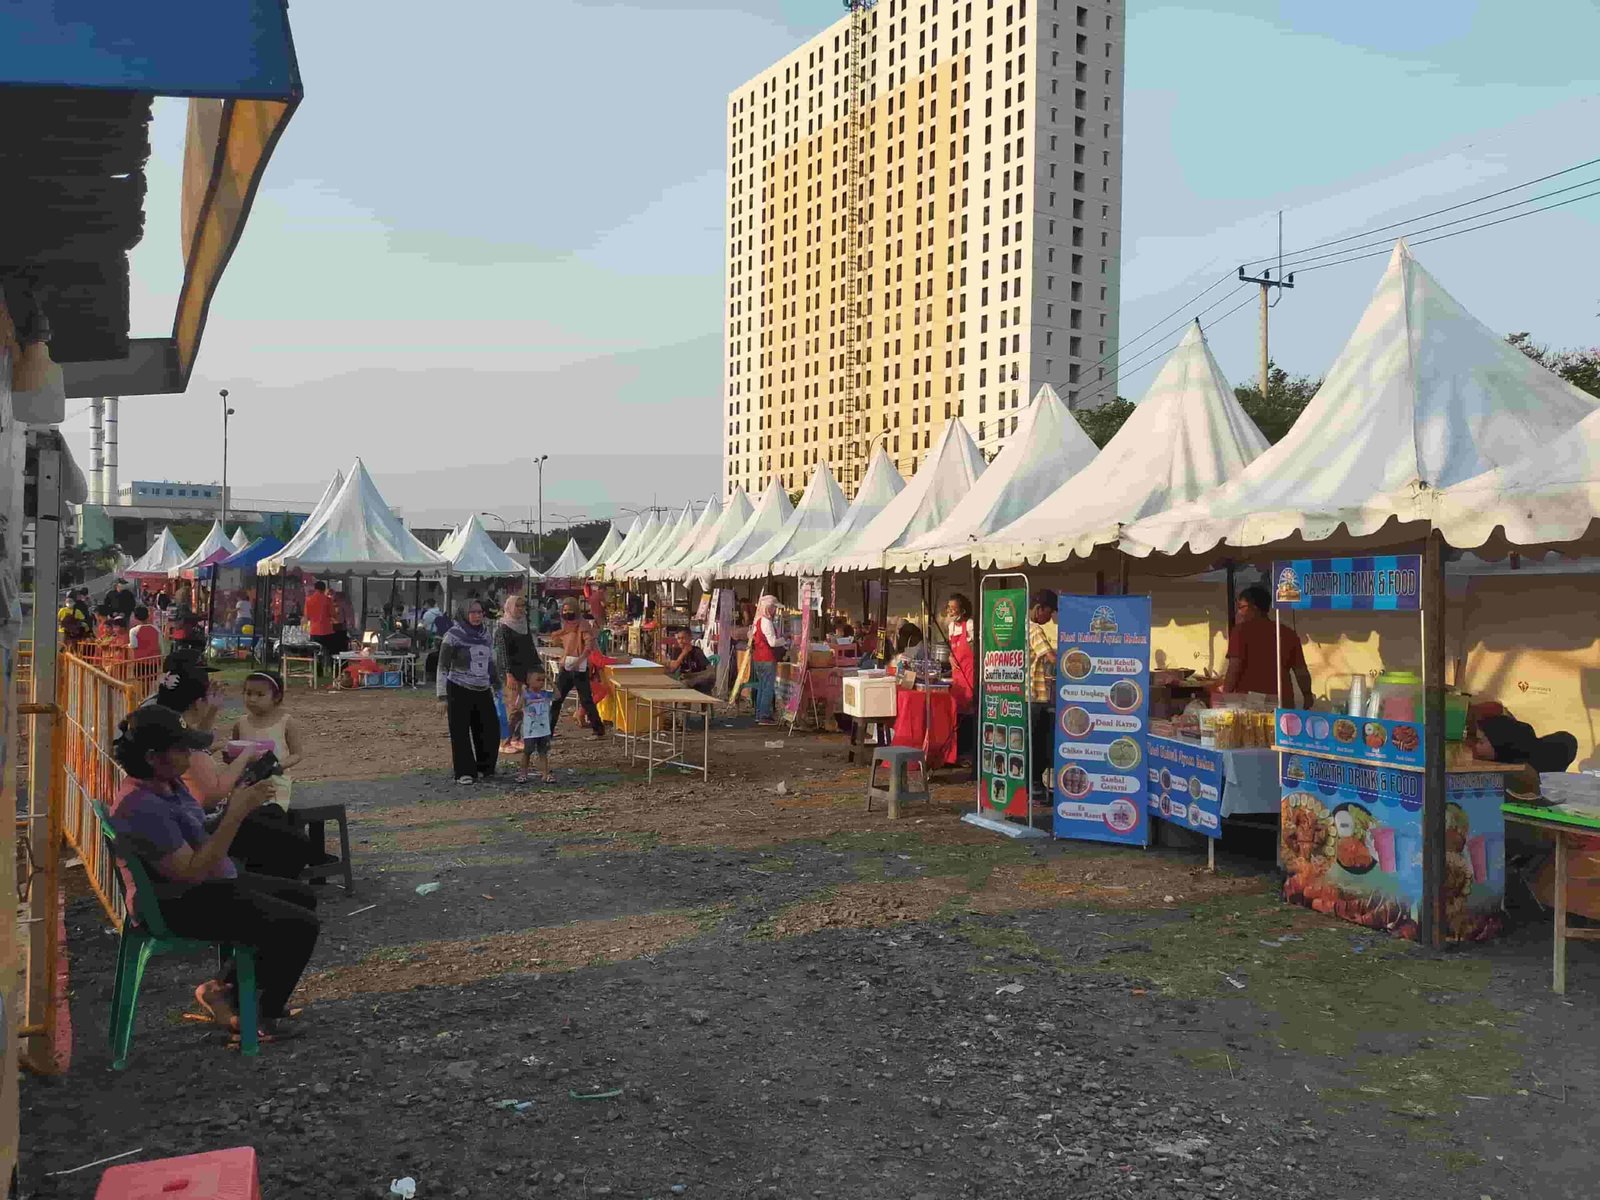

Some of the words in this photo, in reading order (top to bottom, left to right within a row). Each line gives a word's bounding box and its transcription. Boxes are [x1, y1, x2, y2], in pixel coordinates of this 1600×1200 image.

[1303, 571, 1340, 596] GAYATRI
[1344, 570, 1375, 596] DRINK
[1378, 569, 1385, 596] &
[1388, 568, 1416, 596] FOOD
[984, 651, 1023, 669] JAPANESE
[1002, 668, 1023, 681] Pancake
[1308, 761, 1346, 785] GAYATRI
[1348, 767, 1378, 791] DRINK
[1380, 771, 1387, 791] &
[1389, 773, 1418, 798] FOOD
